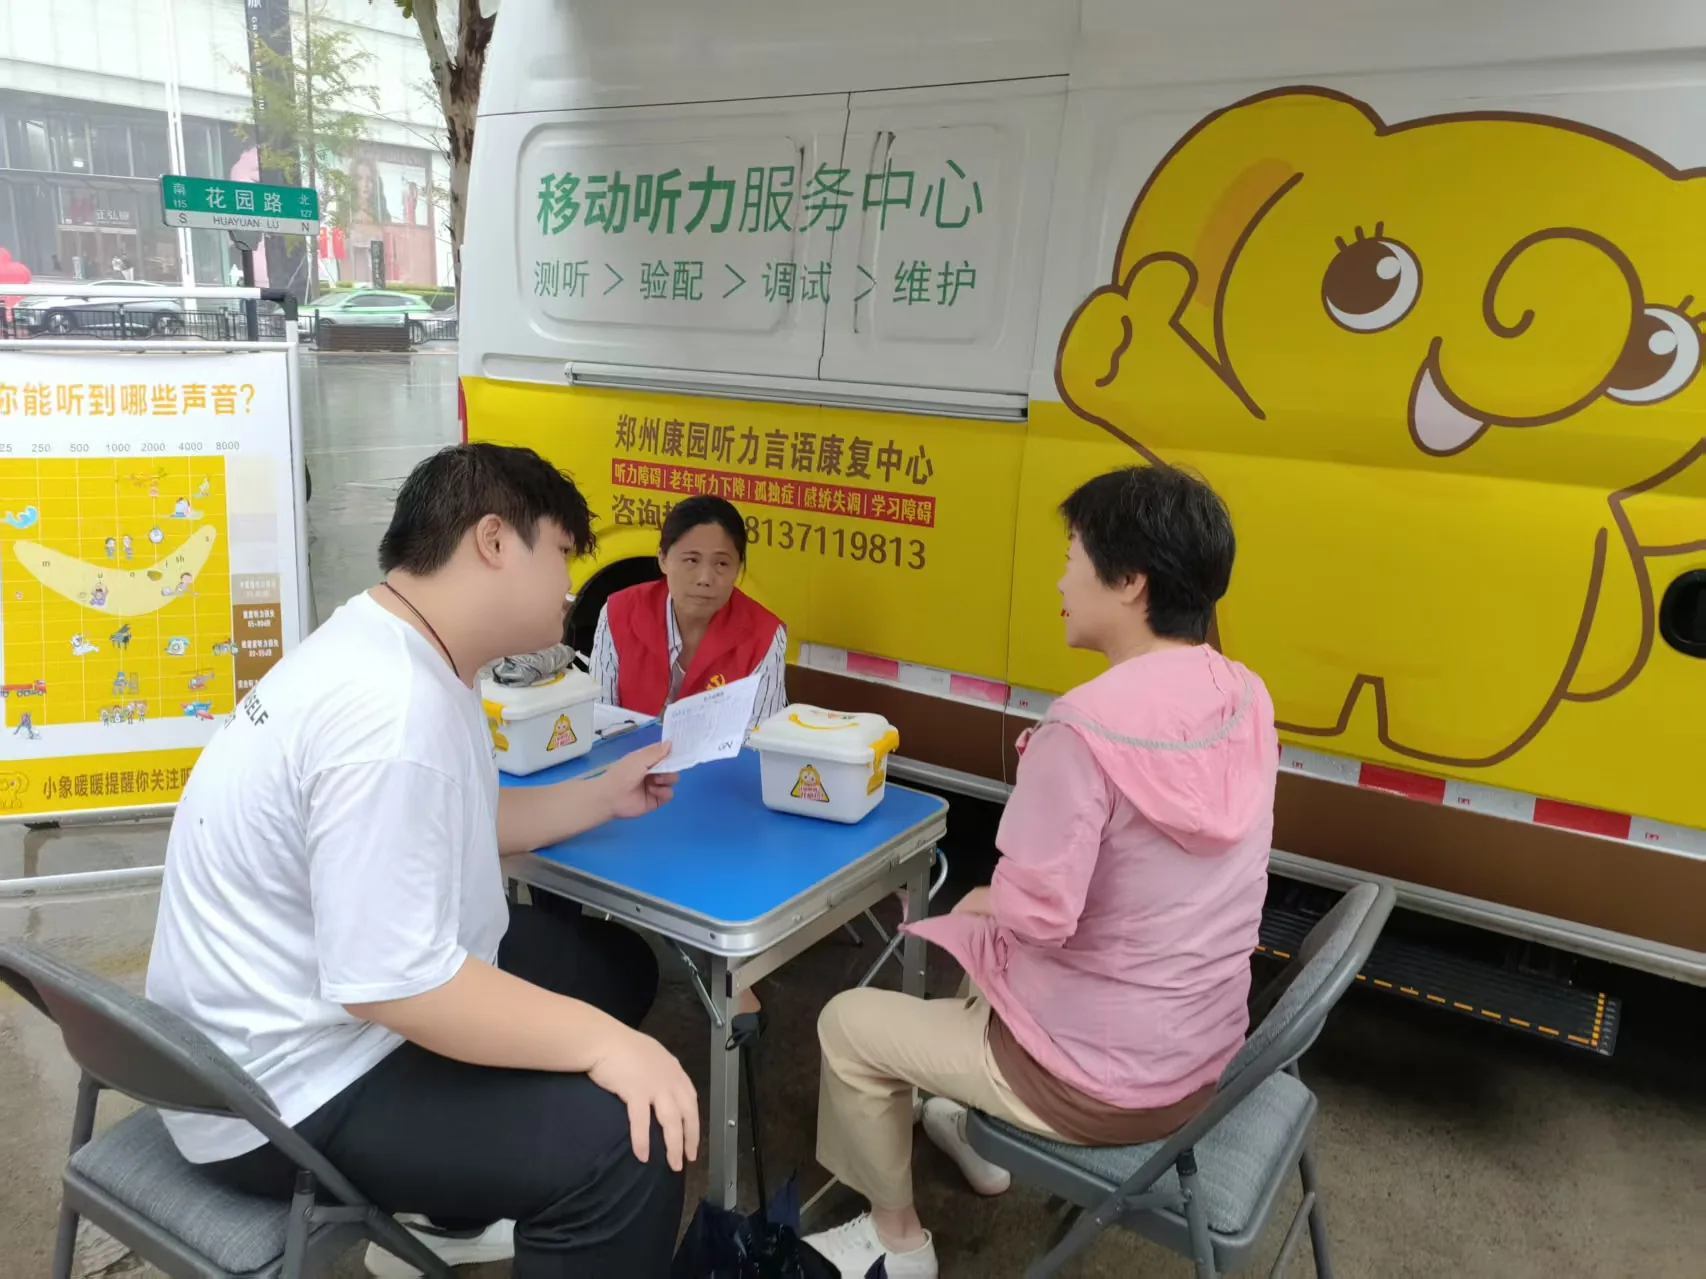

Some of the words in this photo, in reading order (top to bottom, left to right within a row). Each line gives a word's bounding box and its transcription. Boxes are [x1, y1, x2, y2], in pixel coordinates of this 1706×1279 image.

[172, 183, 186, 196] 南
[205, 187, 283, 212] 花园路
[298, 194, 310, 205] 北
[173, 199, 188, 209] 115
[300, 209, 312, 218] 127
[536, 158, 984, 236] 移动听力服务中心
[178, 212, 188, 224] S
[212, 215, 261, 229] HUAYUAN
[266, 219, 280, 229] LU
[301, 222, 310, 232] N
[533, 259, 590, 299] 测听
[640, 259, 703, 301] 验配
[762, 261, 833, 303] 调试
[892, 258, 977, 307] 维护
[0, 383, 256, 417] 你能听到哪些声音?
[31, 443, 51, 453] 250
[69, 443, 90, 453] 500
[105, 442, 131, 453] 1000
[140, 442, 166, 452] 2000
[178, 441, 203, 451] 4000
[215, 440, 240, 450] 8000
[615, 413, 934, 486] 郑州康园听力言语康复中心
[614, 463, 662, 489] 听力障碍
[669, 470, 746, 499] 老年听力下降
[753, 480, 795, 505] 孤独症
[803, 486, 861, 516] 感统失调
[871, 494, 933, 525] 学习障碍
